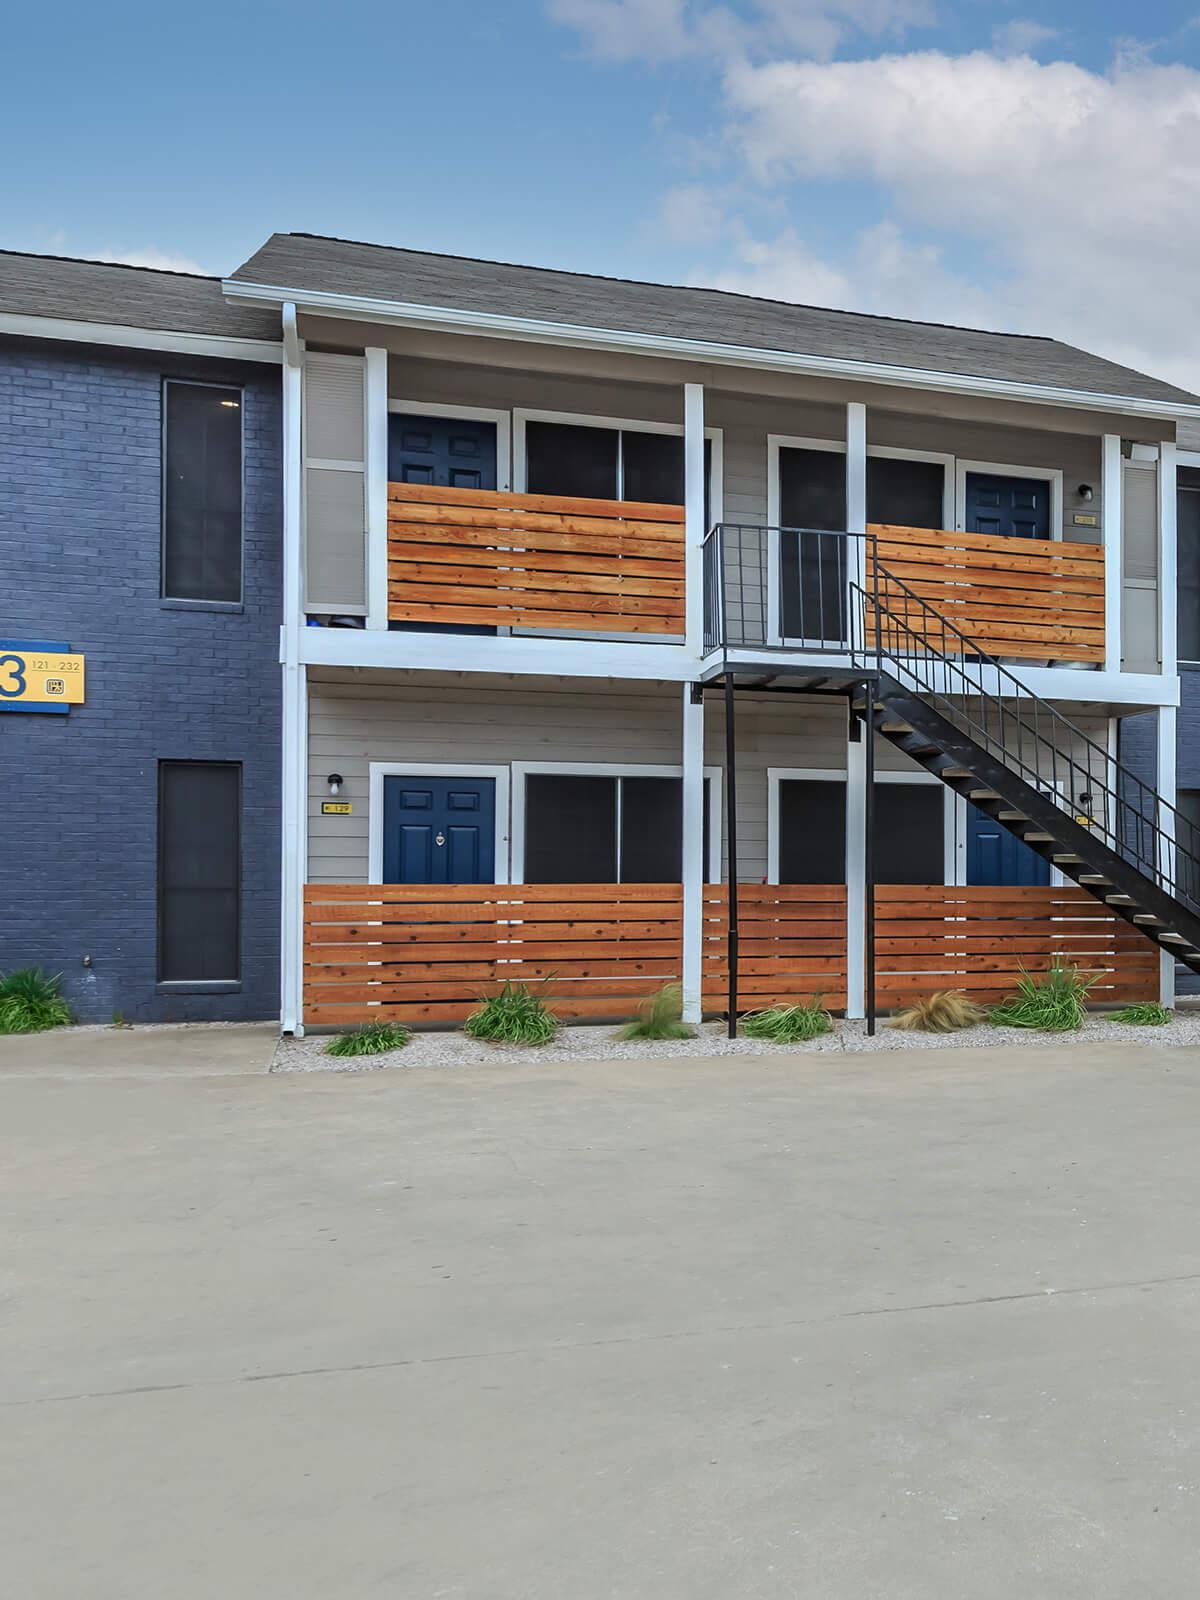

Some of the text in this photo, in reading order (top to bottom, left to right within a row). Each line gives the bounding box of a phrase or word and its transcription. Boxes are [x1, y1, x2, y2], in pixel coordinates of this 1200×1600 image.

[0, 655, 26, 697] 3
[32, 660, 48, 669] 121
[60, 662, 80, 671] 232
